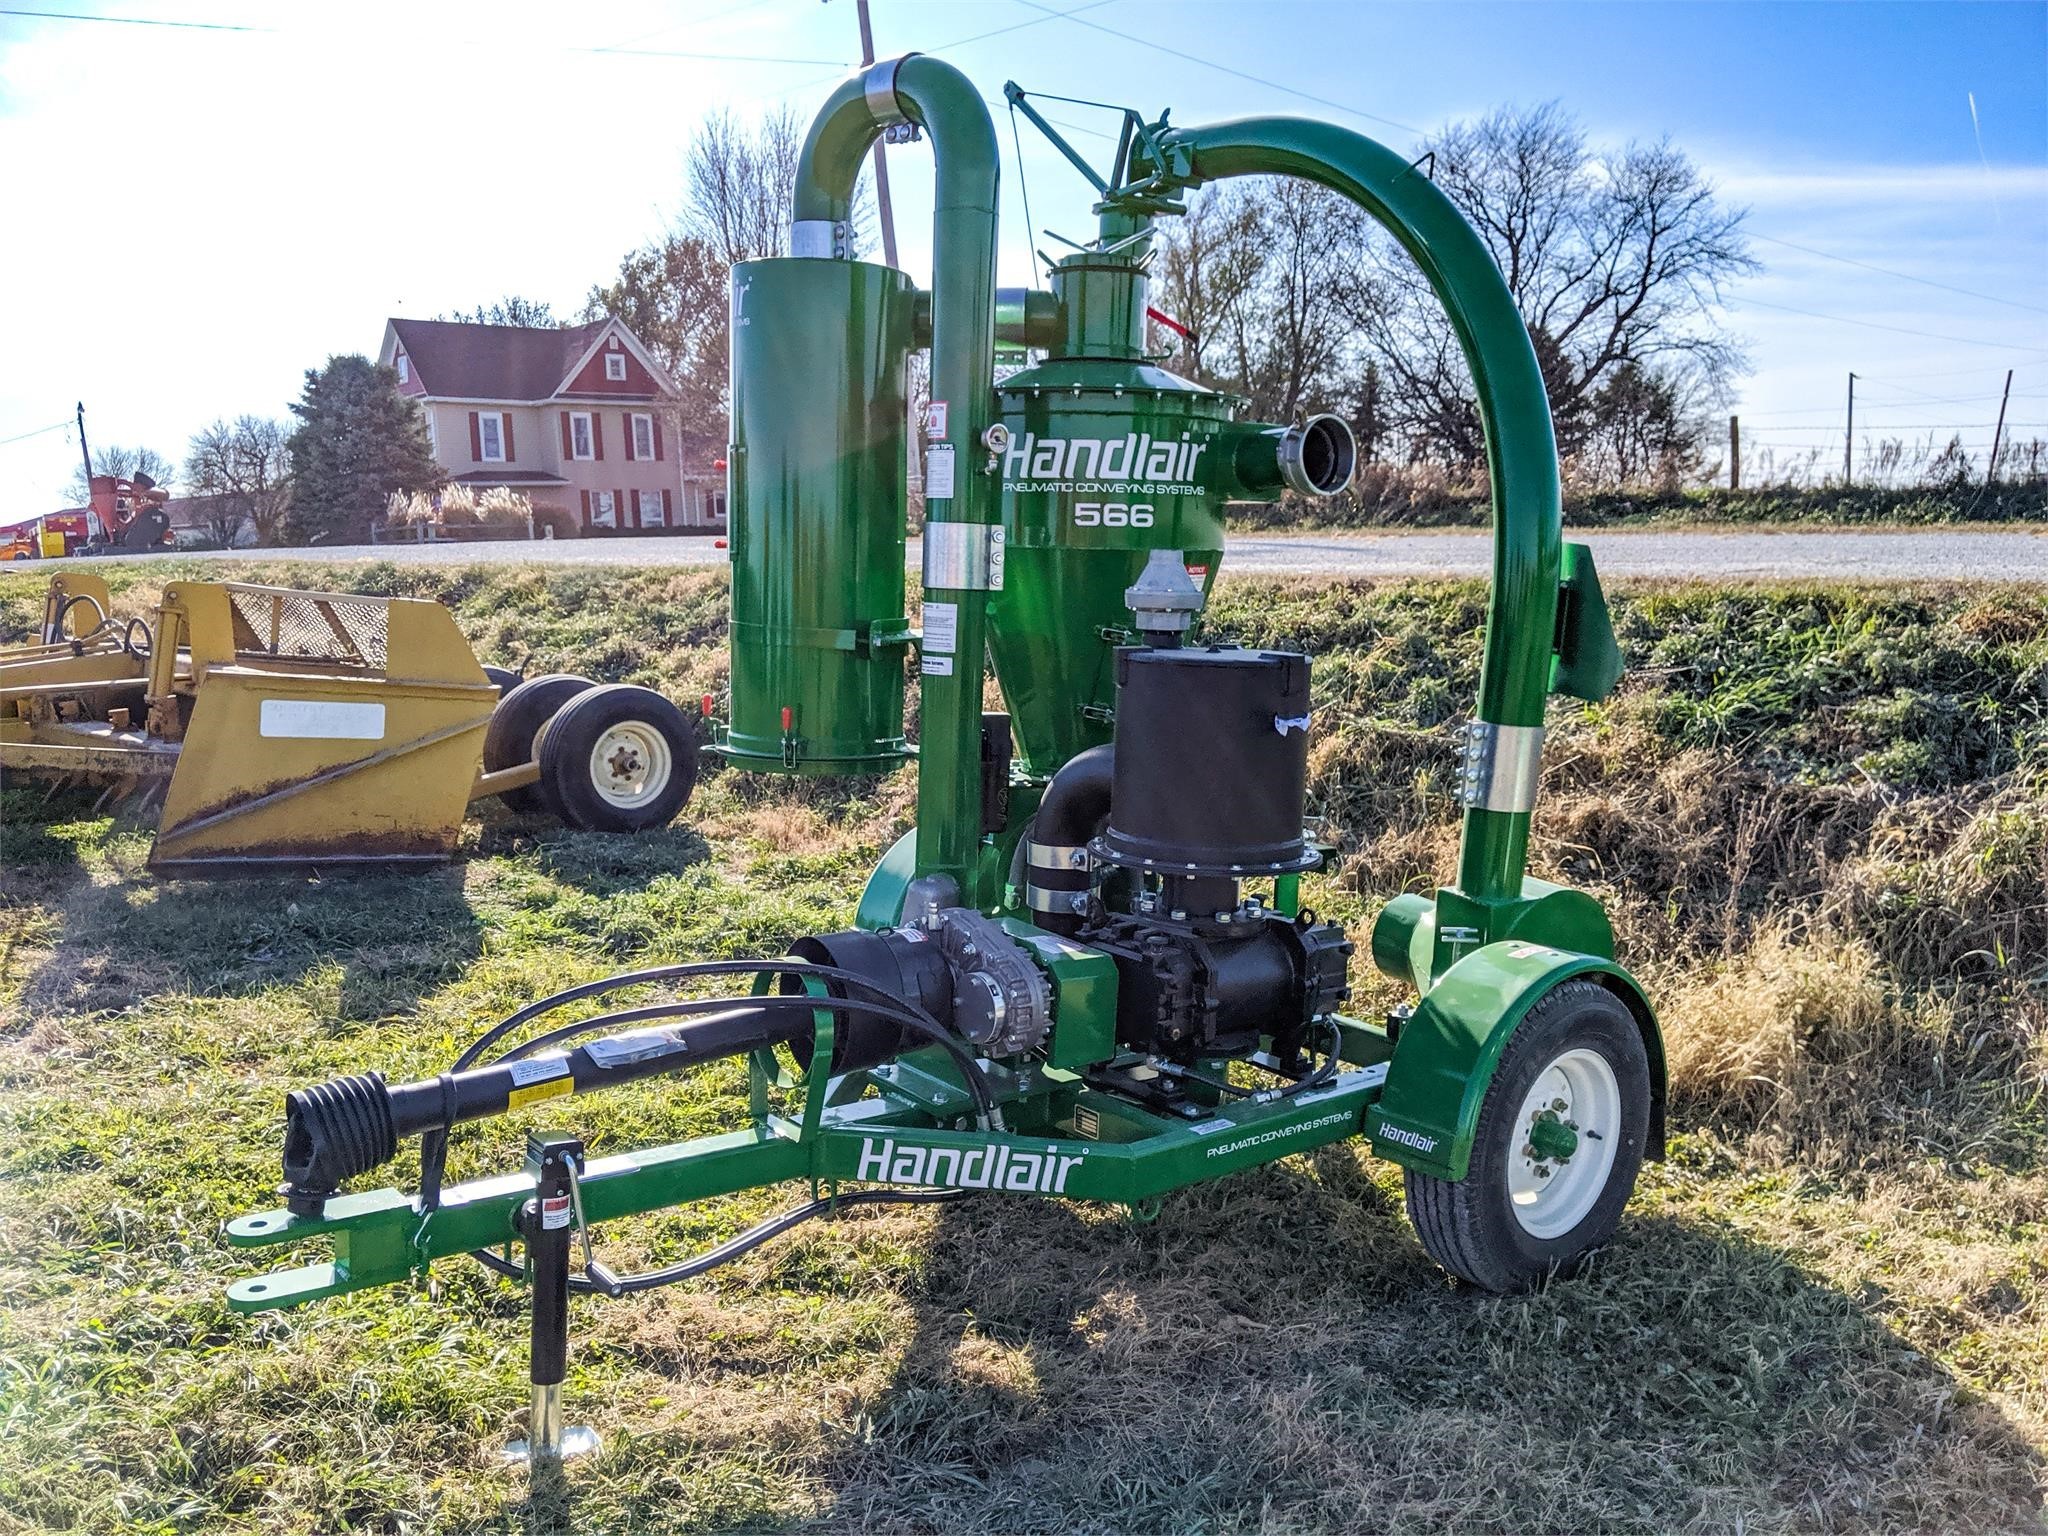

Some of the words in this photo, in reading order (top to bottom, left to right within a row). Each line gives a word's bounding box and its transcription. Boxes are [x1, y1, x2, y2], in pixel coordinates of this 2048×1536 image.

[1002, 431, 1207, 482] Handlair
[1003, 482, 1073, 493] PNEUMATIC
[1075, 482, 1155, 494] CONVEYING
[1156, 484, 1205, 496] SYSTEMS
[1074, 503, 1155, 528] 566
[1206, 1135, 1260, 1158] PNEUMATIC
[1260, 1121, 1312, 1143] CONVEYING
[1312, 1110, 1353, 1129] SYSTEMS
[1378, 1121, 1438, 1153] Handlair
[856, 1136, 1084, 1193] Handlair
